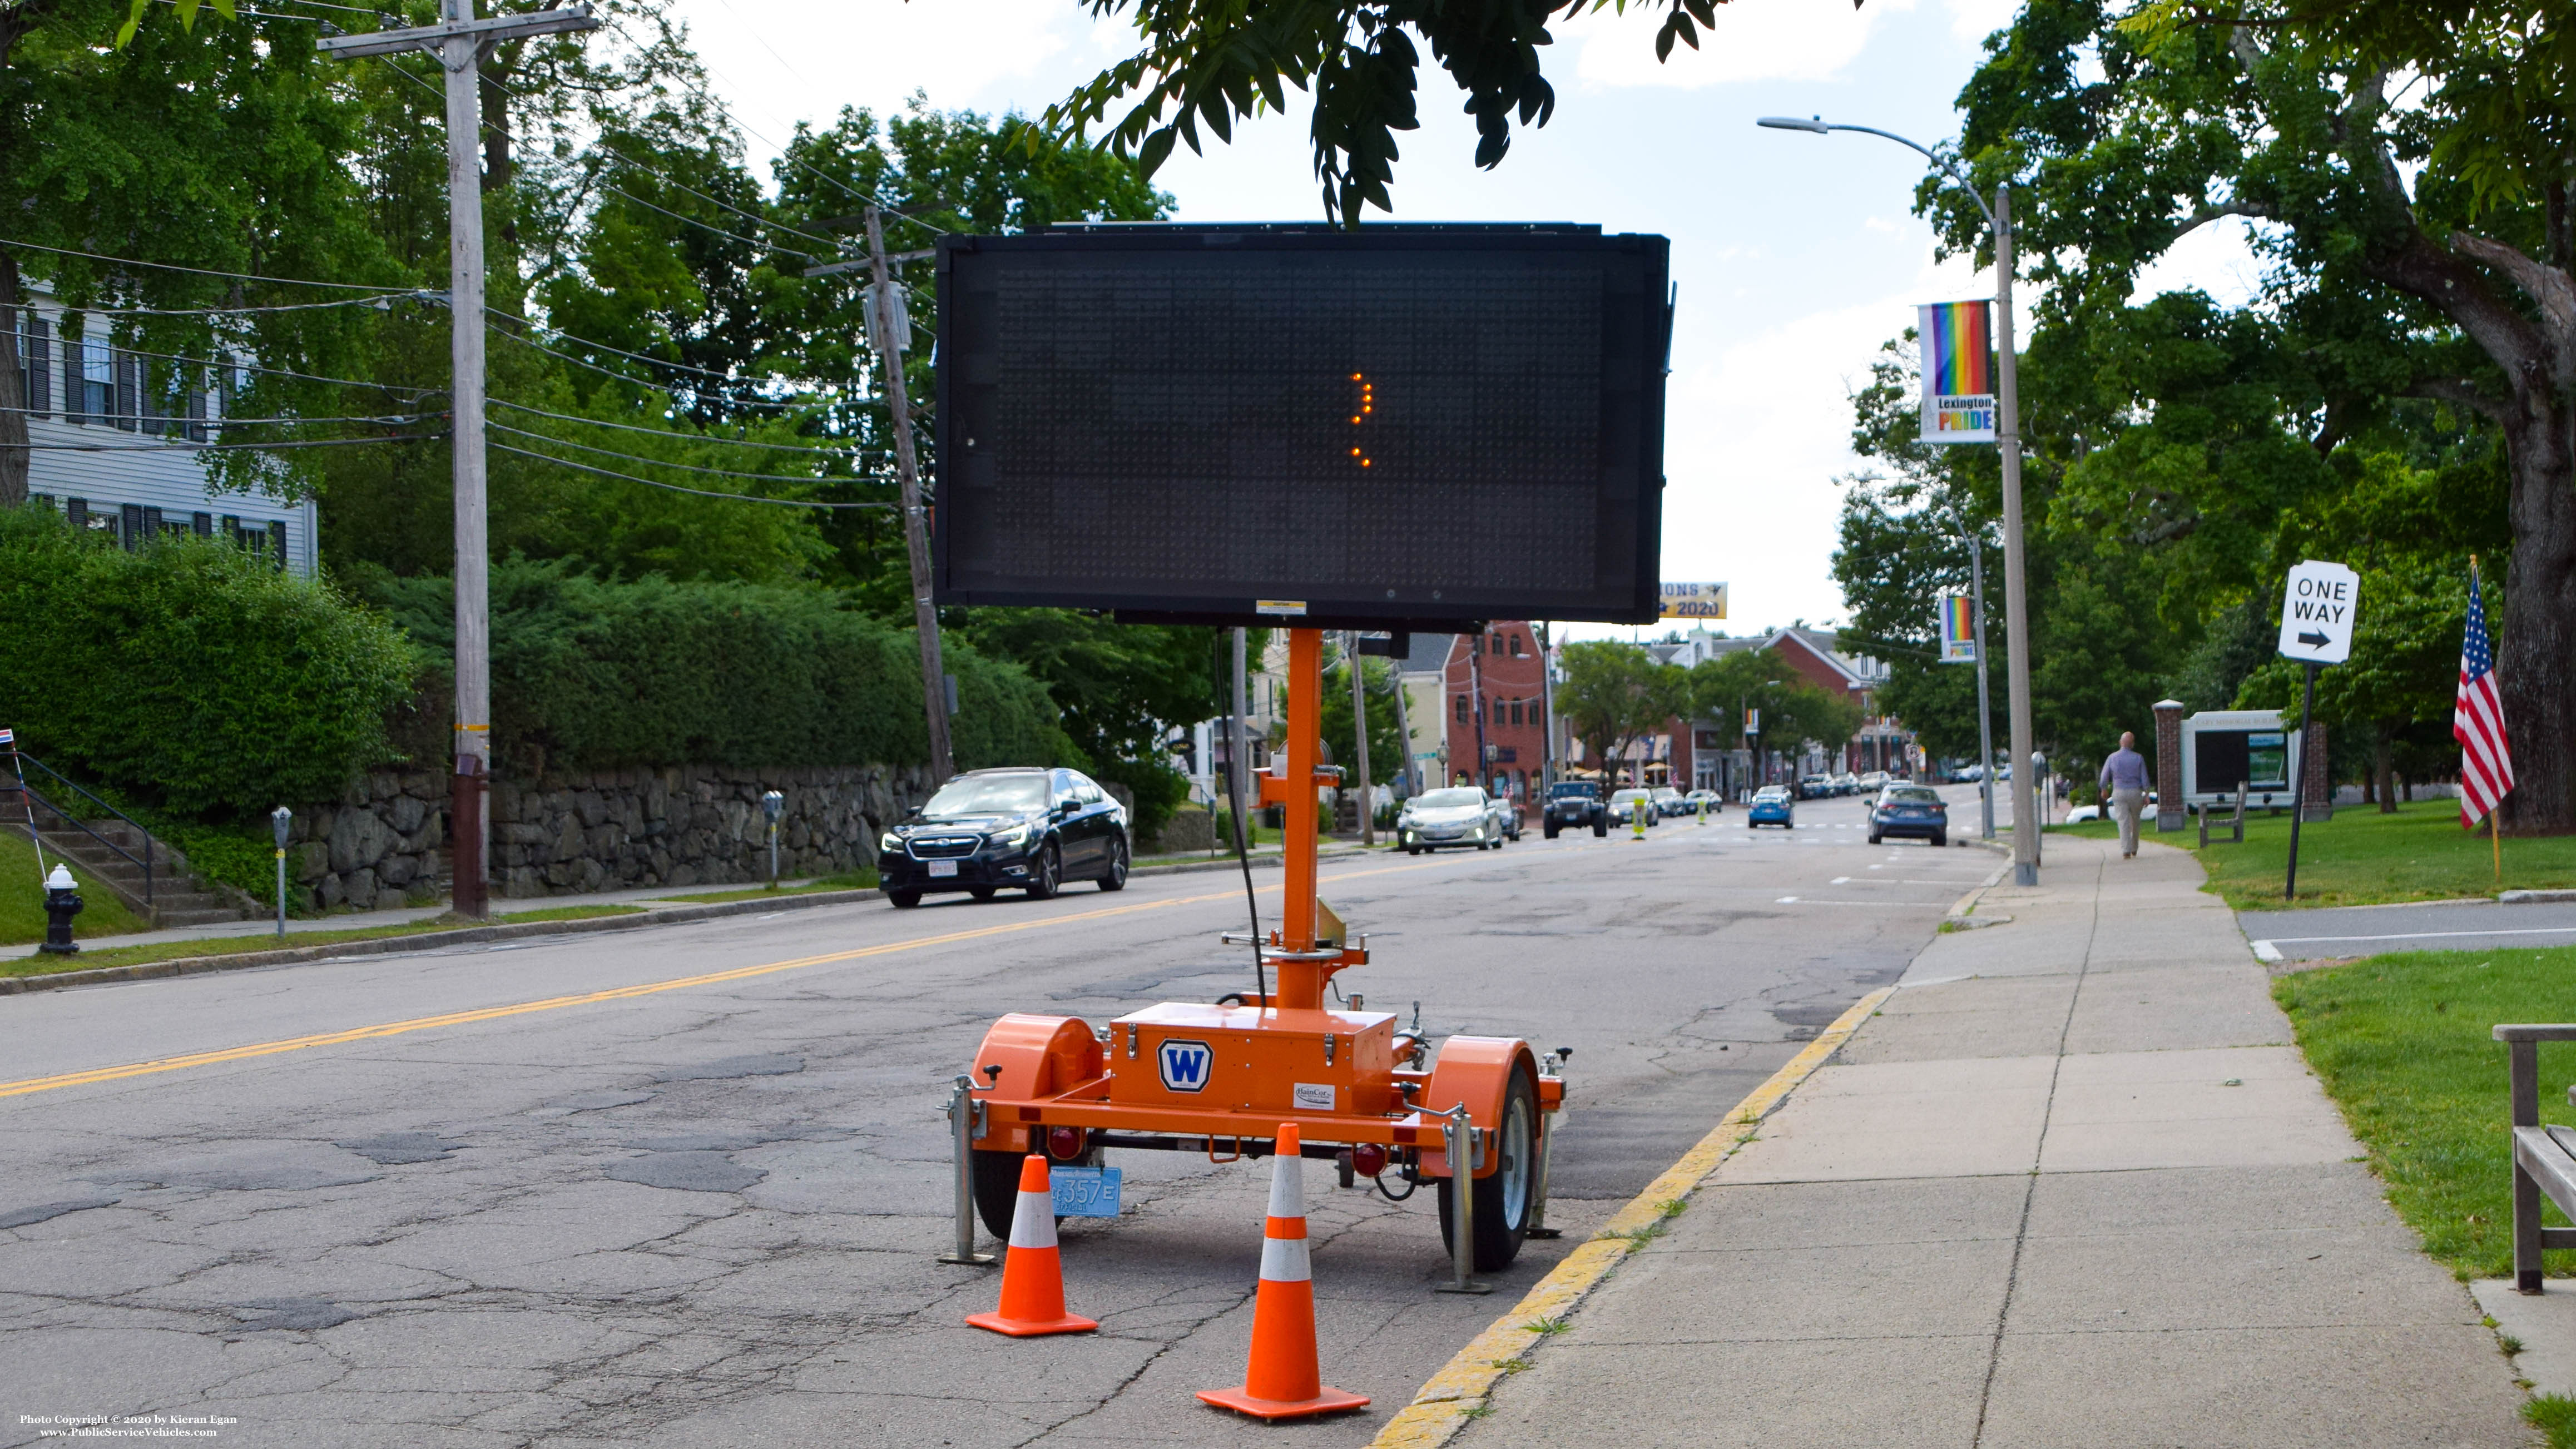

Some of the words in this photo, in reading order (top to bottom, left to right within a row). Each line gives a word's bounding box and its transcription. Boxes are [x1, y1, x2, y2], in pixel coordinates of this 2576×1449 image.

[1939, 397, 1992, 409] Lexington
[1939, 410, 1992, 430] PRIDE
[2297, 578, 2347, 601] ONE
[1677, 602, 1719, 616] 2020
[2295, 601, 2345, 623] WAY
[1167, 1049, 1205, 1083] W
